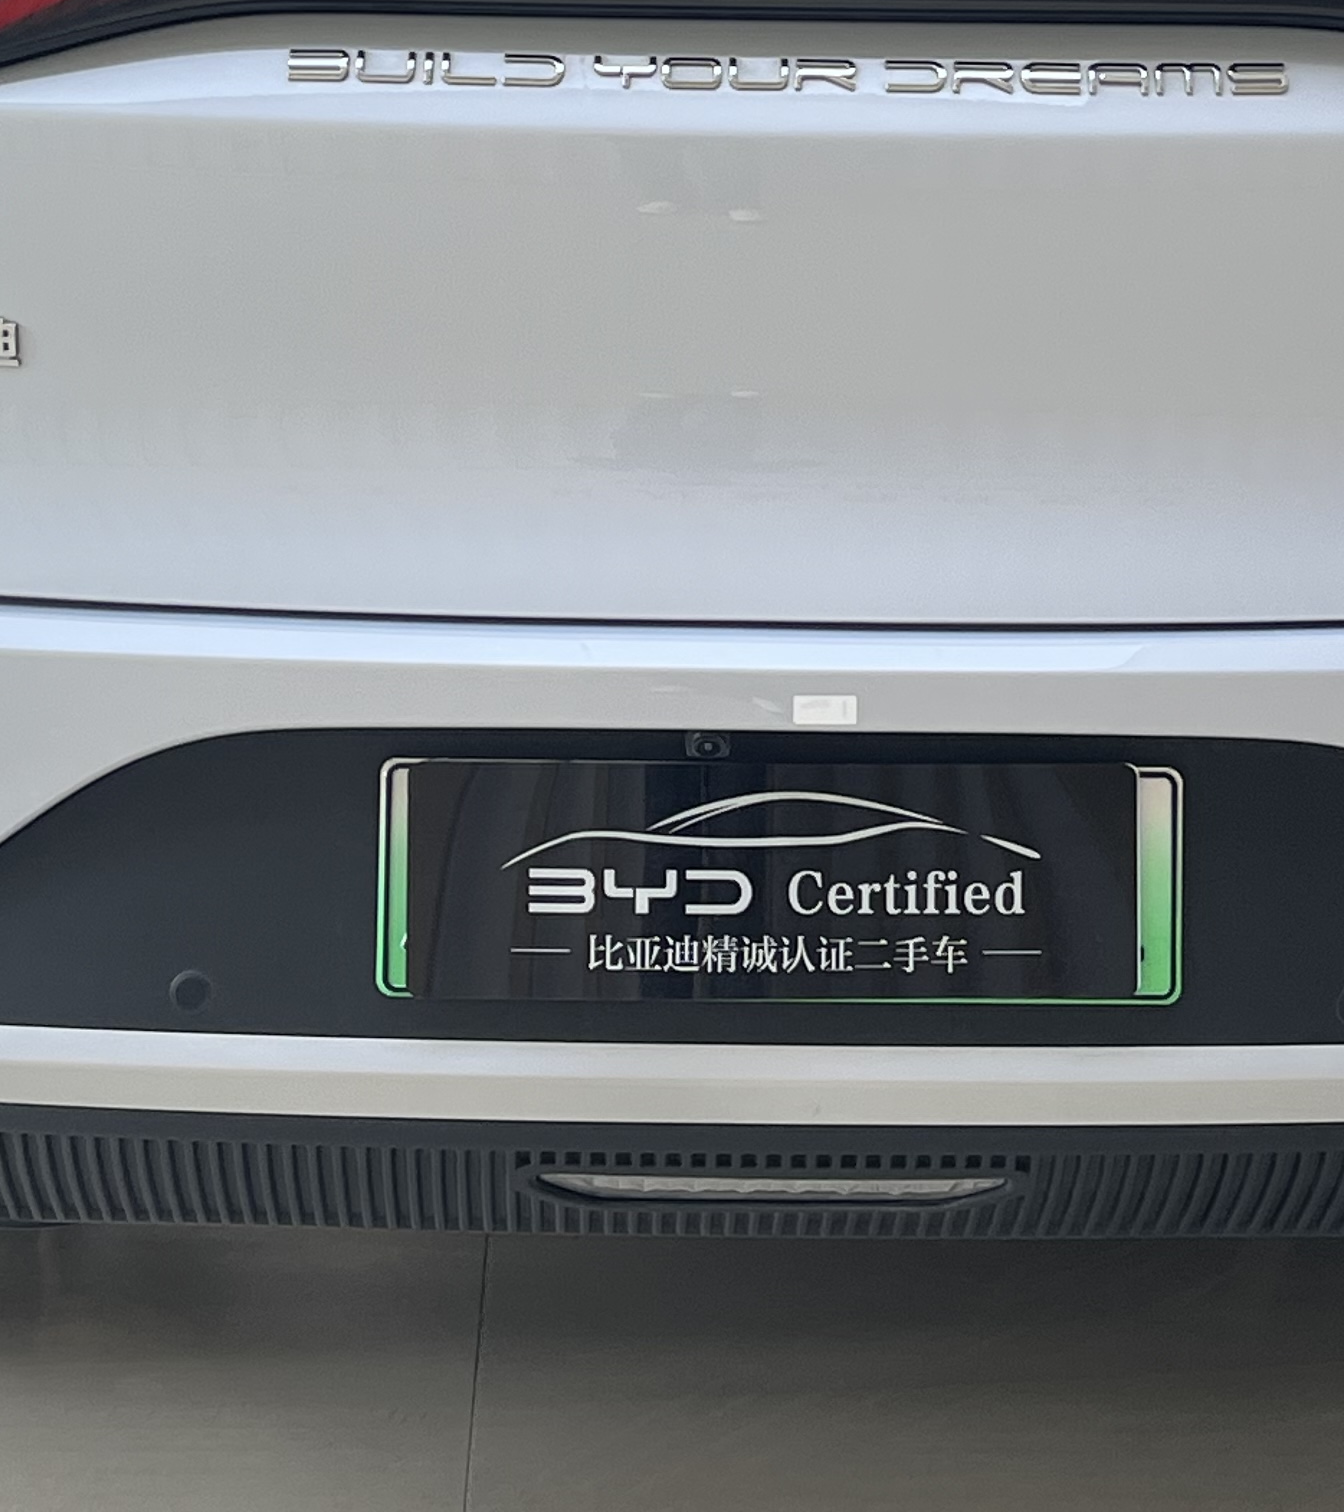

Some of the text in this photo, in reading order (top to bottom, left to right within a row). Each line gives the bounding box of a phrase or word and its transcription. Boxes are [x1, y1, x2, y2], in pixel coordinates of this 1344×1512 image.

[287, 48, 1290, 97] BUILD YOUR DREAMS
[527, 867, 1025, 917] BYD Certified
[587, 935, 969, 974] 比亚迪精诚认证二手车
